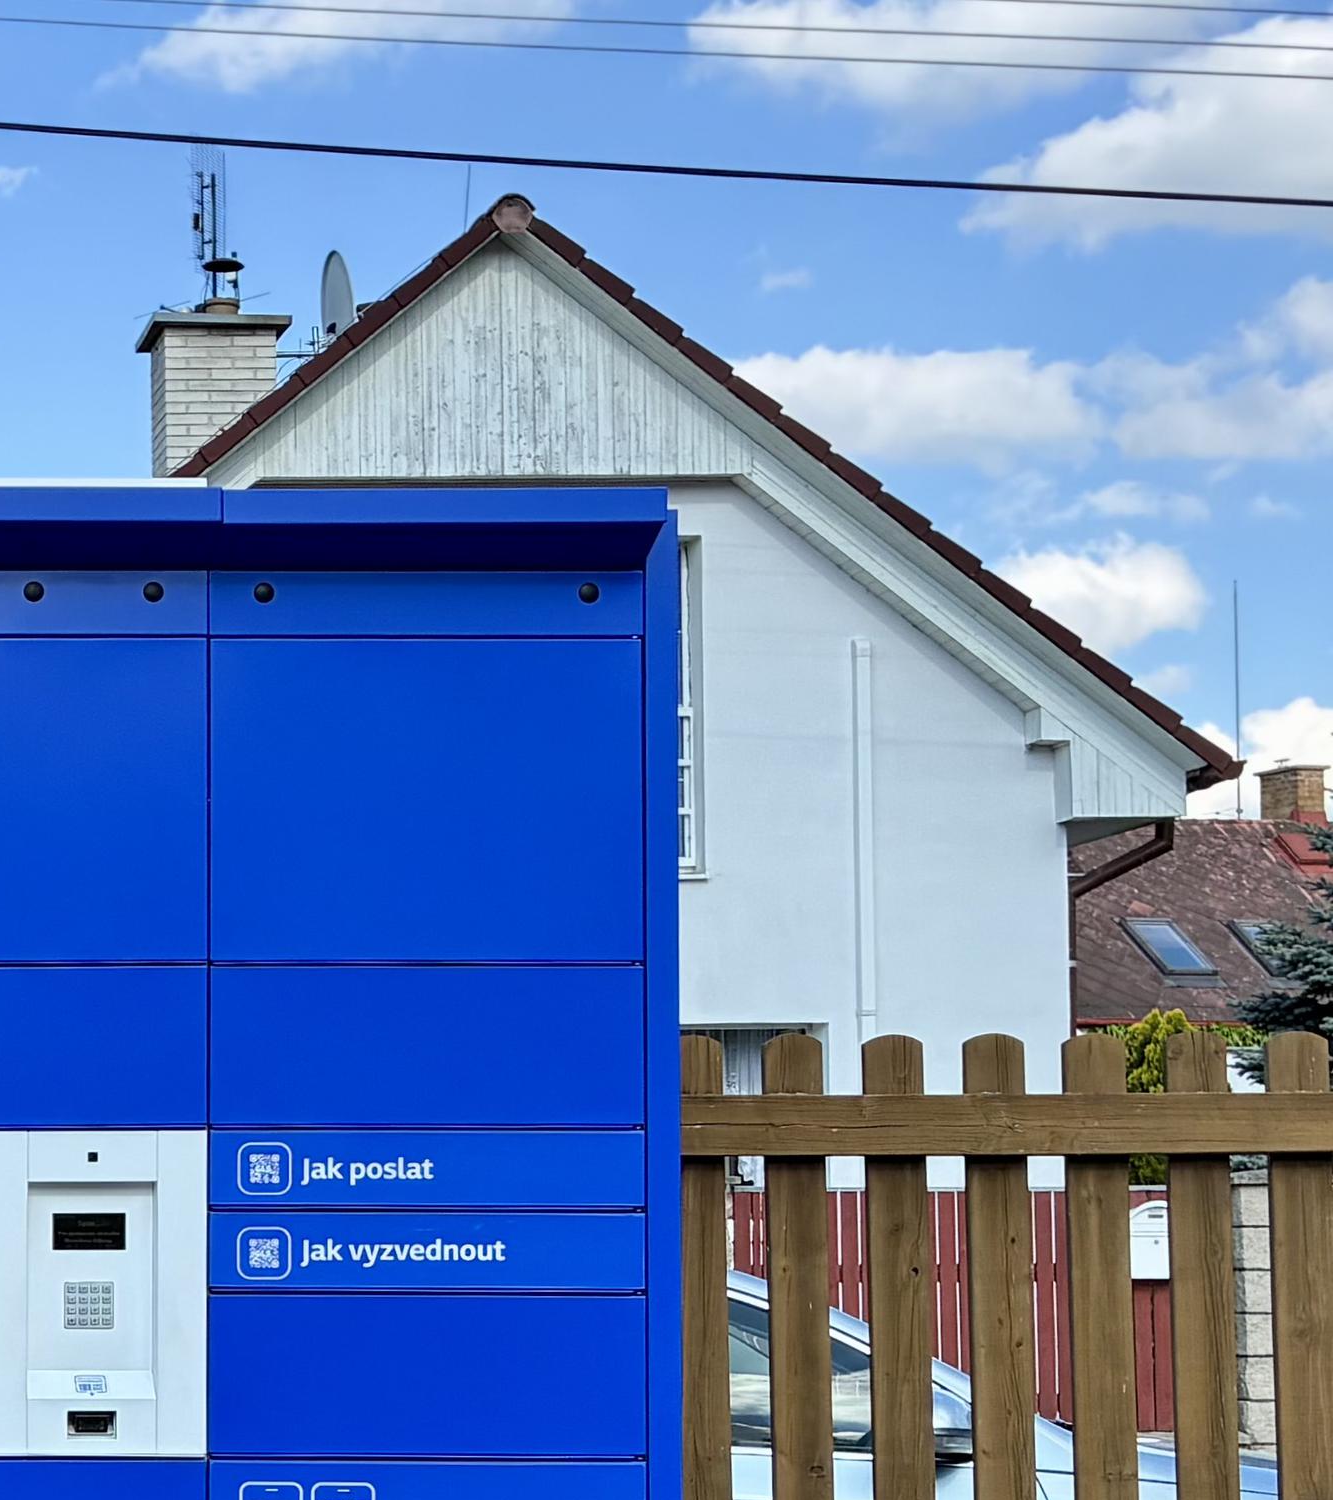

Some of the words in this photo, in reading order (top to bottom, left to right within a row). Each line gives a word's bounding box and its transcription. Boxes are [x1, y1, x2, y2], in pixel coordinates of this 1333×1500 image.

[301, 1157, 343, 1186] Jak
[350, 1157, 434, 1186] poslat
[301, 1239, 343, 1268] Jak
[348, 1239, 505, 1268] vyzvednout
